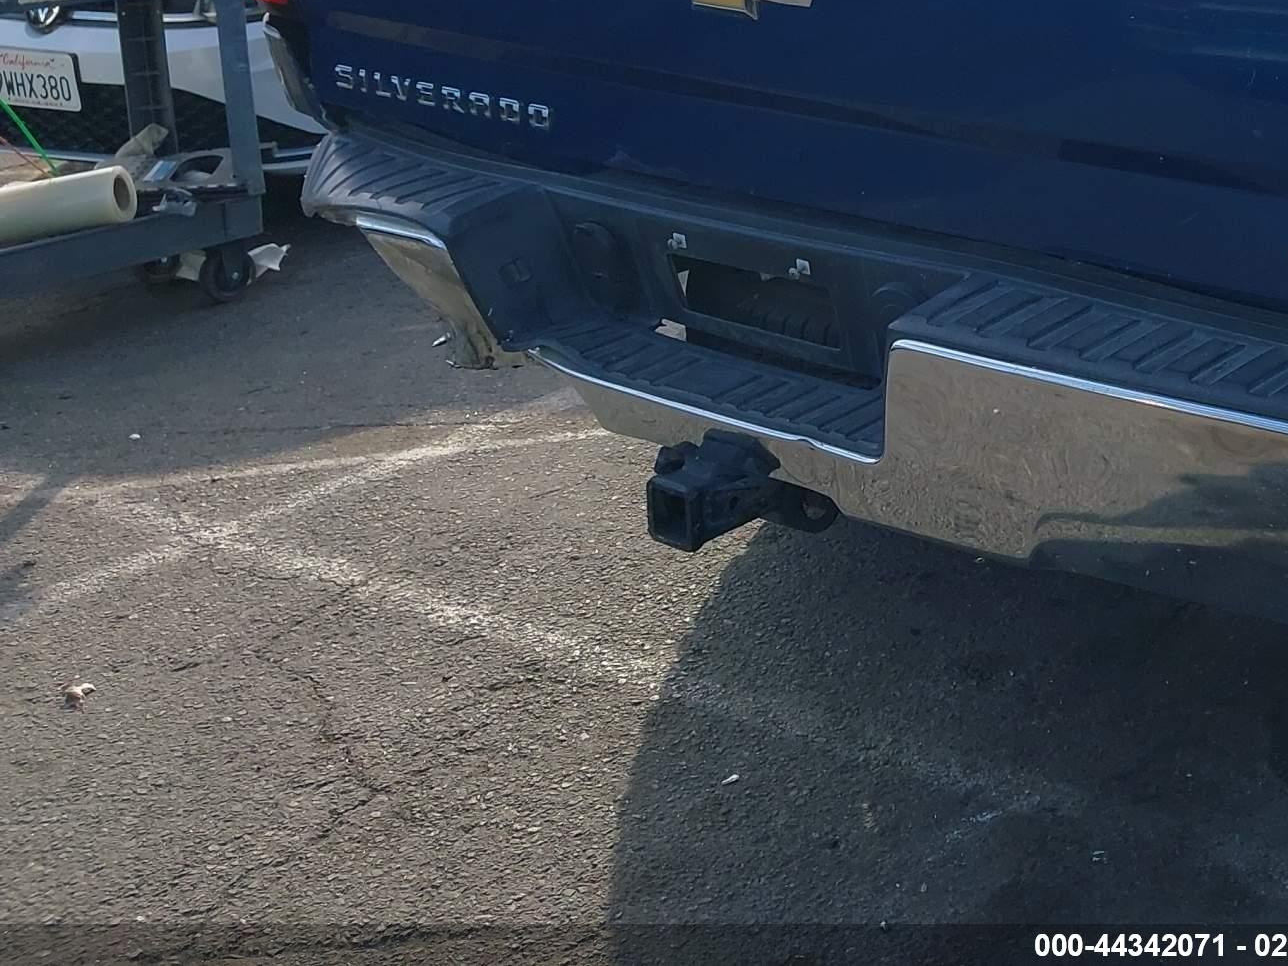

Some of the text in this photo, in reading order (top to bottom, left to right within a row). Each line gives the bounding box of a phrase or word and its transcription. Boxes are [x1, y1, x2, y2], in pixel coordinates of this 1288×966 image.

[3, 52, 51, 70] California
[0, 70, 72, 102] WHX380
[333, 64, 552, 128] SILVERADO
